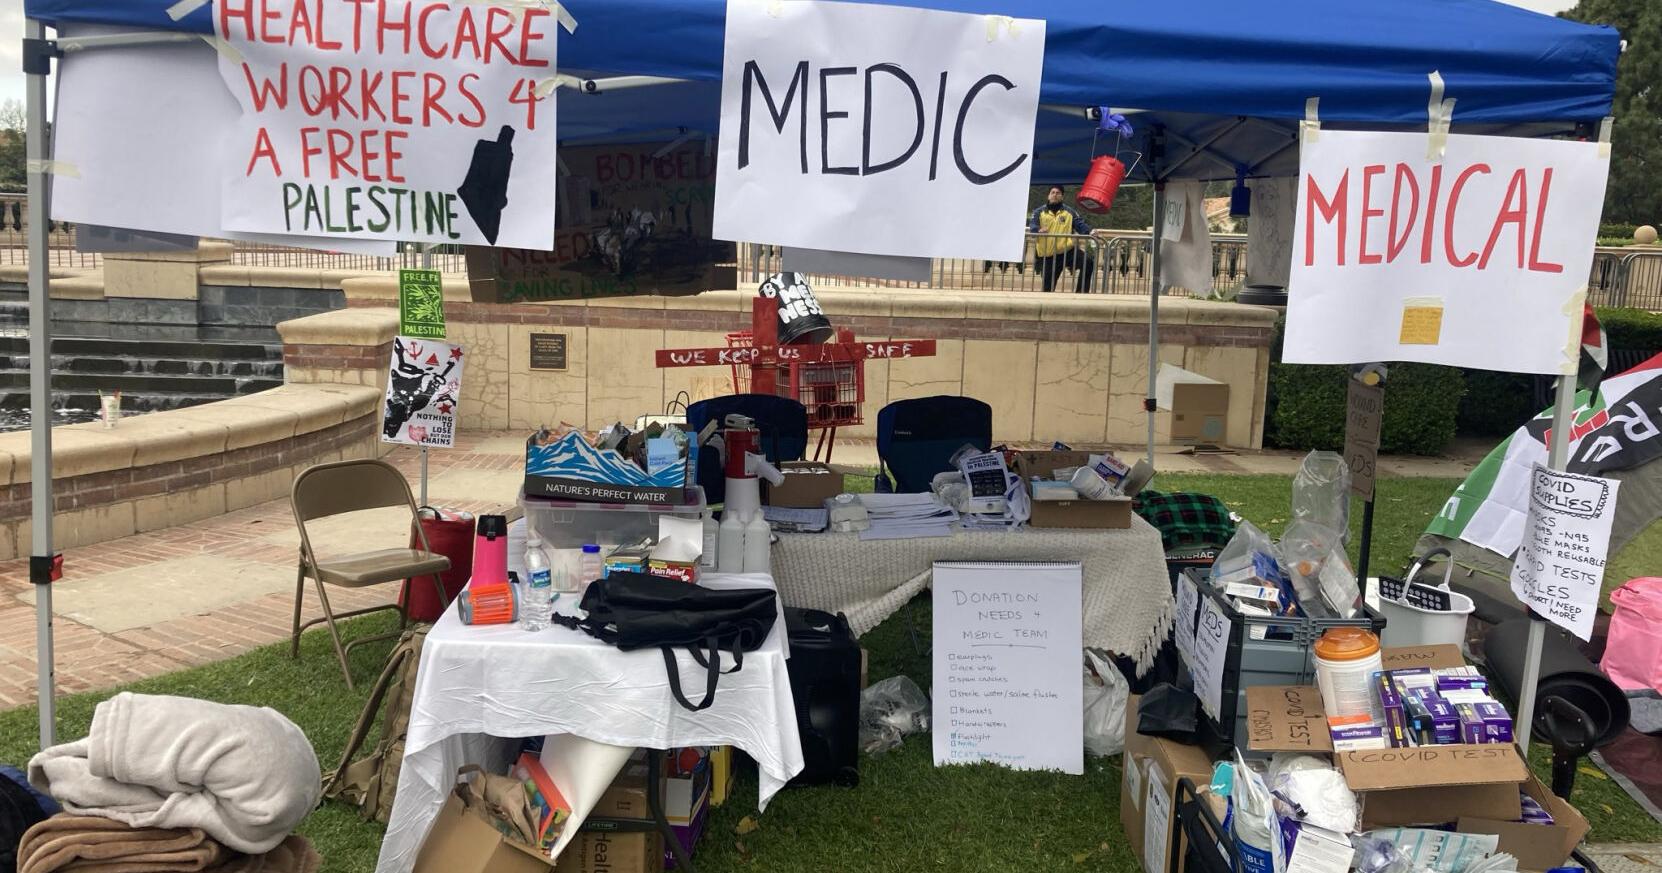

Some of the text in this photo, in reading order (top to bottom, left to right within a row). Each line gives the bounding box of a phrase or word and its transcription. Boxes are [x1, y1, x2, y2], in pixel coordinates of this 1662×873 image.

[220, 0, 551, 67] HEALTHCARE
[242, 62, 544, 130] WORKERS 4
[737, 59, 1028, 186] MEDIC
[246, 127, 408, 183] A FREE
[283, 182, 461, 239] PALESTINE
[1304, 161, 1564, 274] MEDICAL
[670, 350, 706, 364] WE
[866, 343, 912, 358] SAFE
[416, 413, 453, 422] NOTHING
[421, 436, 451, 445] CHAINS
[1538, 474, 1575, 493] COVID
[545, 484, 665, 502] NATURE'S PERFECT WATER
[1535, 486, 1592, 512] SUPPLIES
[1554, 540, 1590, 553] MASKS
[1557, 550, 1606, 567] REUSABLE
[650, 567, 686, 576] Pain Relief
[1553, 564, 1597, 585] TESTS
[952, 590, 1039, 606] DONATION
[978, 610, 1023, 620] NEEDS
[1549, 608, 1577, 622] MORE
[1556, 601, 1582, 614] NEED
[962, 628, 1049, 640] MEDIC TEAM
[1284, 689, 1312, 746] COVID TEST
[1361, 748, 1511, 763] COVID TEST
